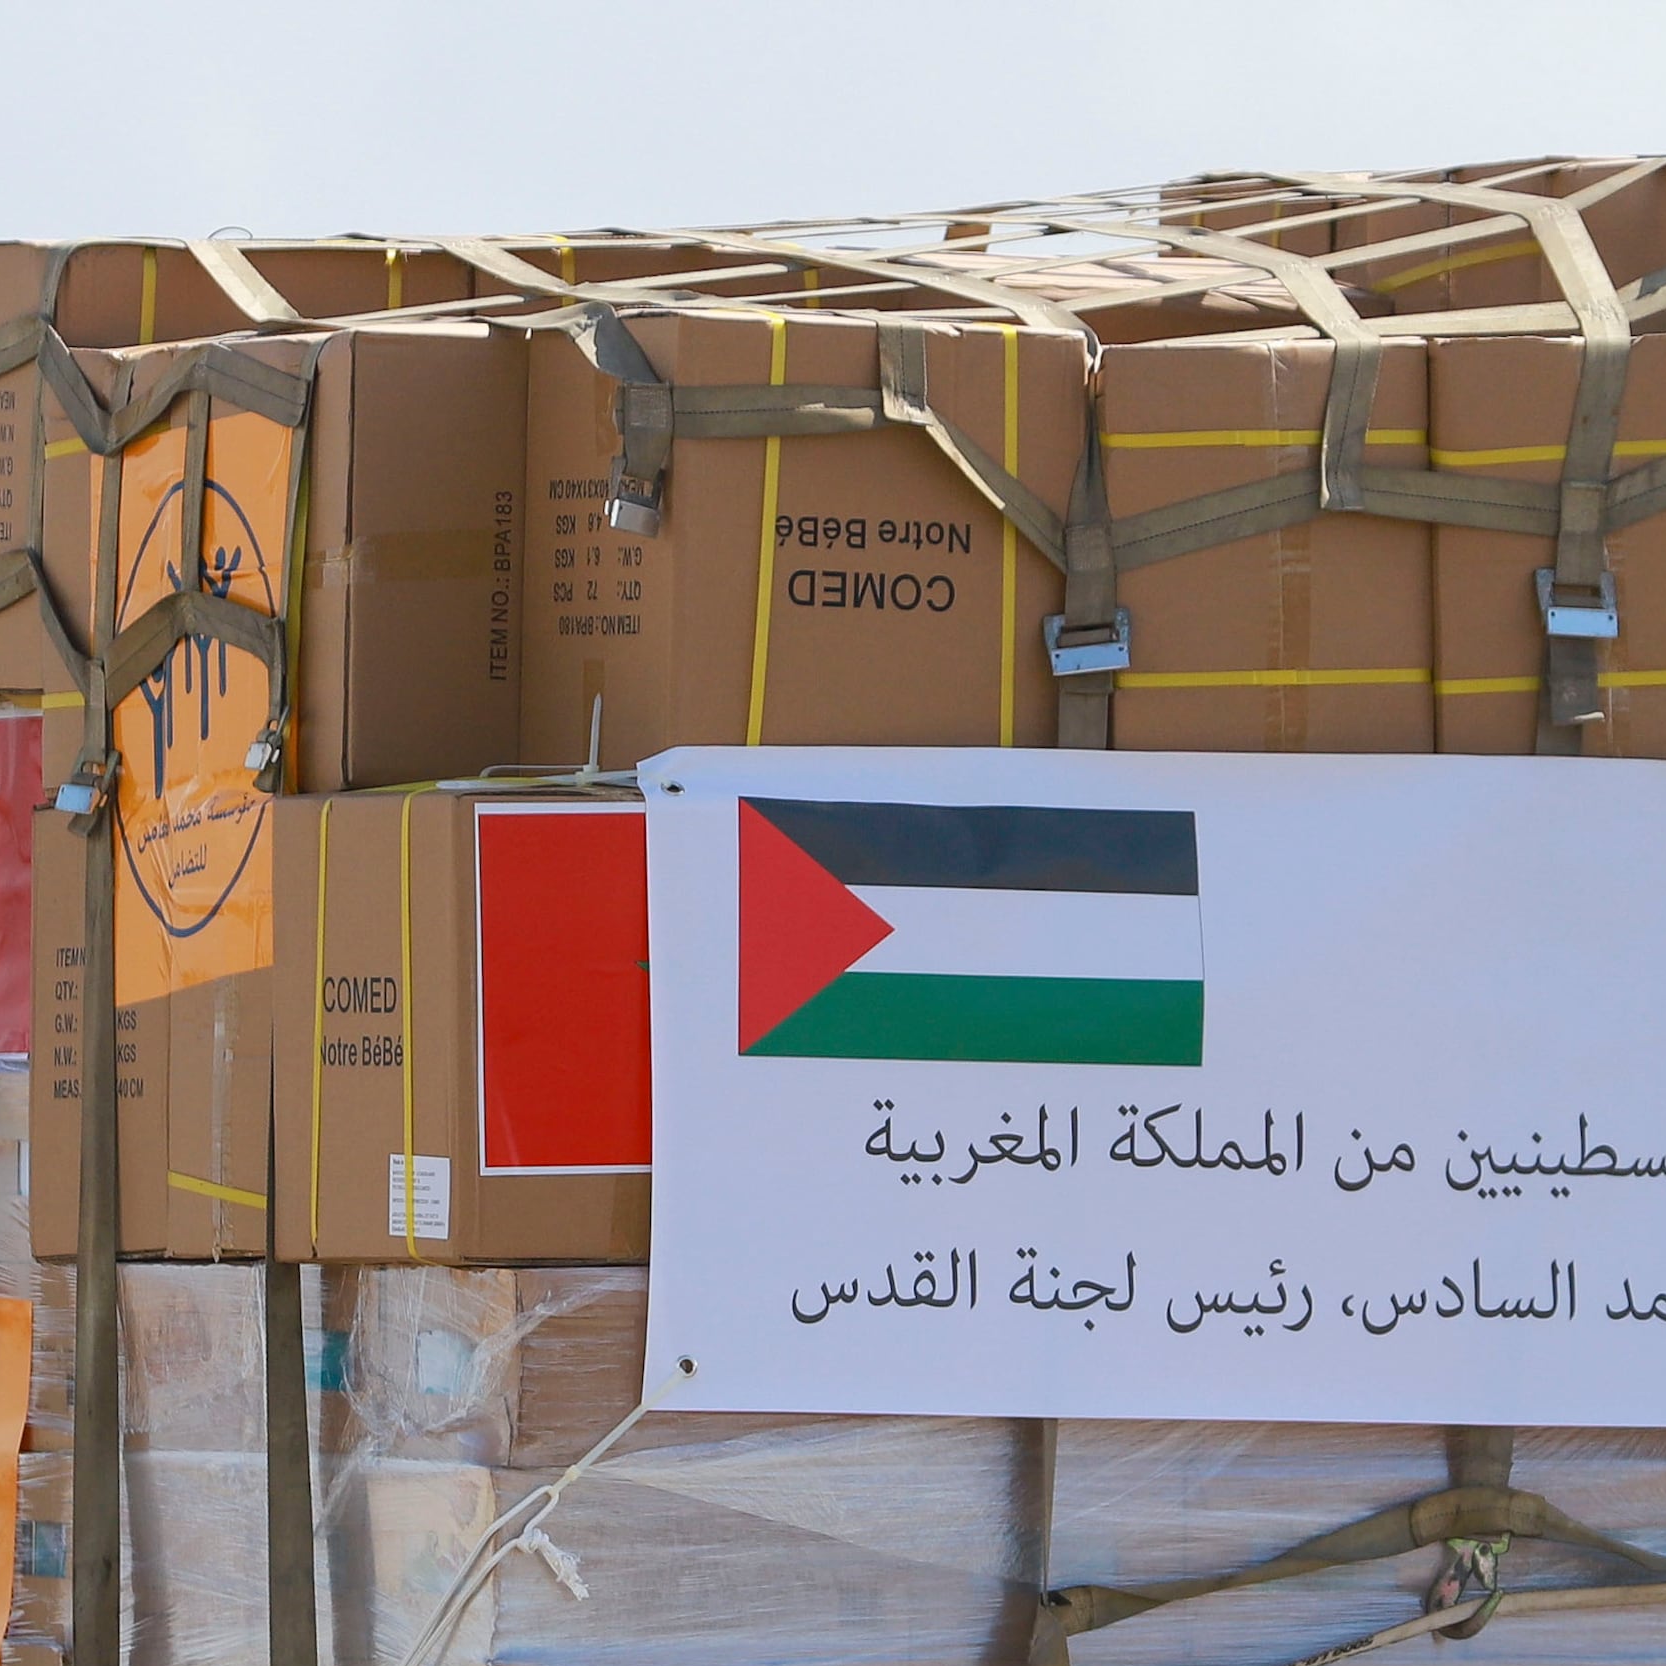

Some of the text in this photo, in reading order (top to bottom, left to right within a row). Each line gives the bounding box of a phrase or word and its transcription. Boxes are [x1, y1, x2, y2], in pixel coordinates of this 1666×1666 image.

[493, 490, 514, 572] BPA183
[555, 515, 576, 535] KGS
[774, 514, 972, 555] Notre BéBé
[554, 548, 575, 569] KGS
[553, 581, 574, 603] PCS
[586, 580, 598, 601] 72
[787, 569, 956, 613] COMED
[489, 629, 509, 682] ITEM
[323, 976, 398, 1014] COMED
[117, 1009, 138, 1031] KGS
[361, 1034, 404, 1067] BéBé
[865, 1097, 1078, 1186] المغربية
[1109, 1102, 1304, 1177] المملكة
[1334, 1127, 1416, 1192] من
[791, 1246, 977, 1325] القدس
[1008, 1246, 1137, 1332] لجنة
[1166, 1257, 1313, 1337] رئيس
[1341, 1256, 1576, 1336] السادس،
